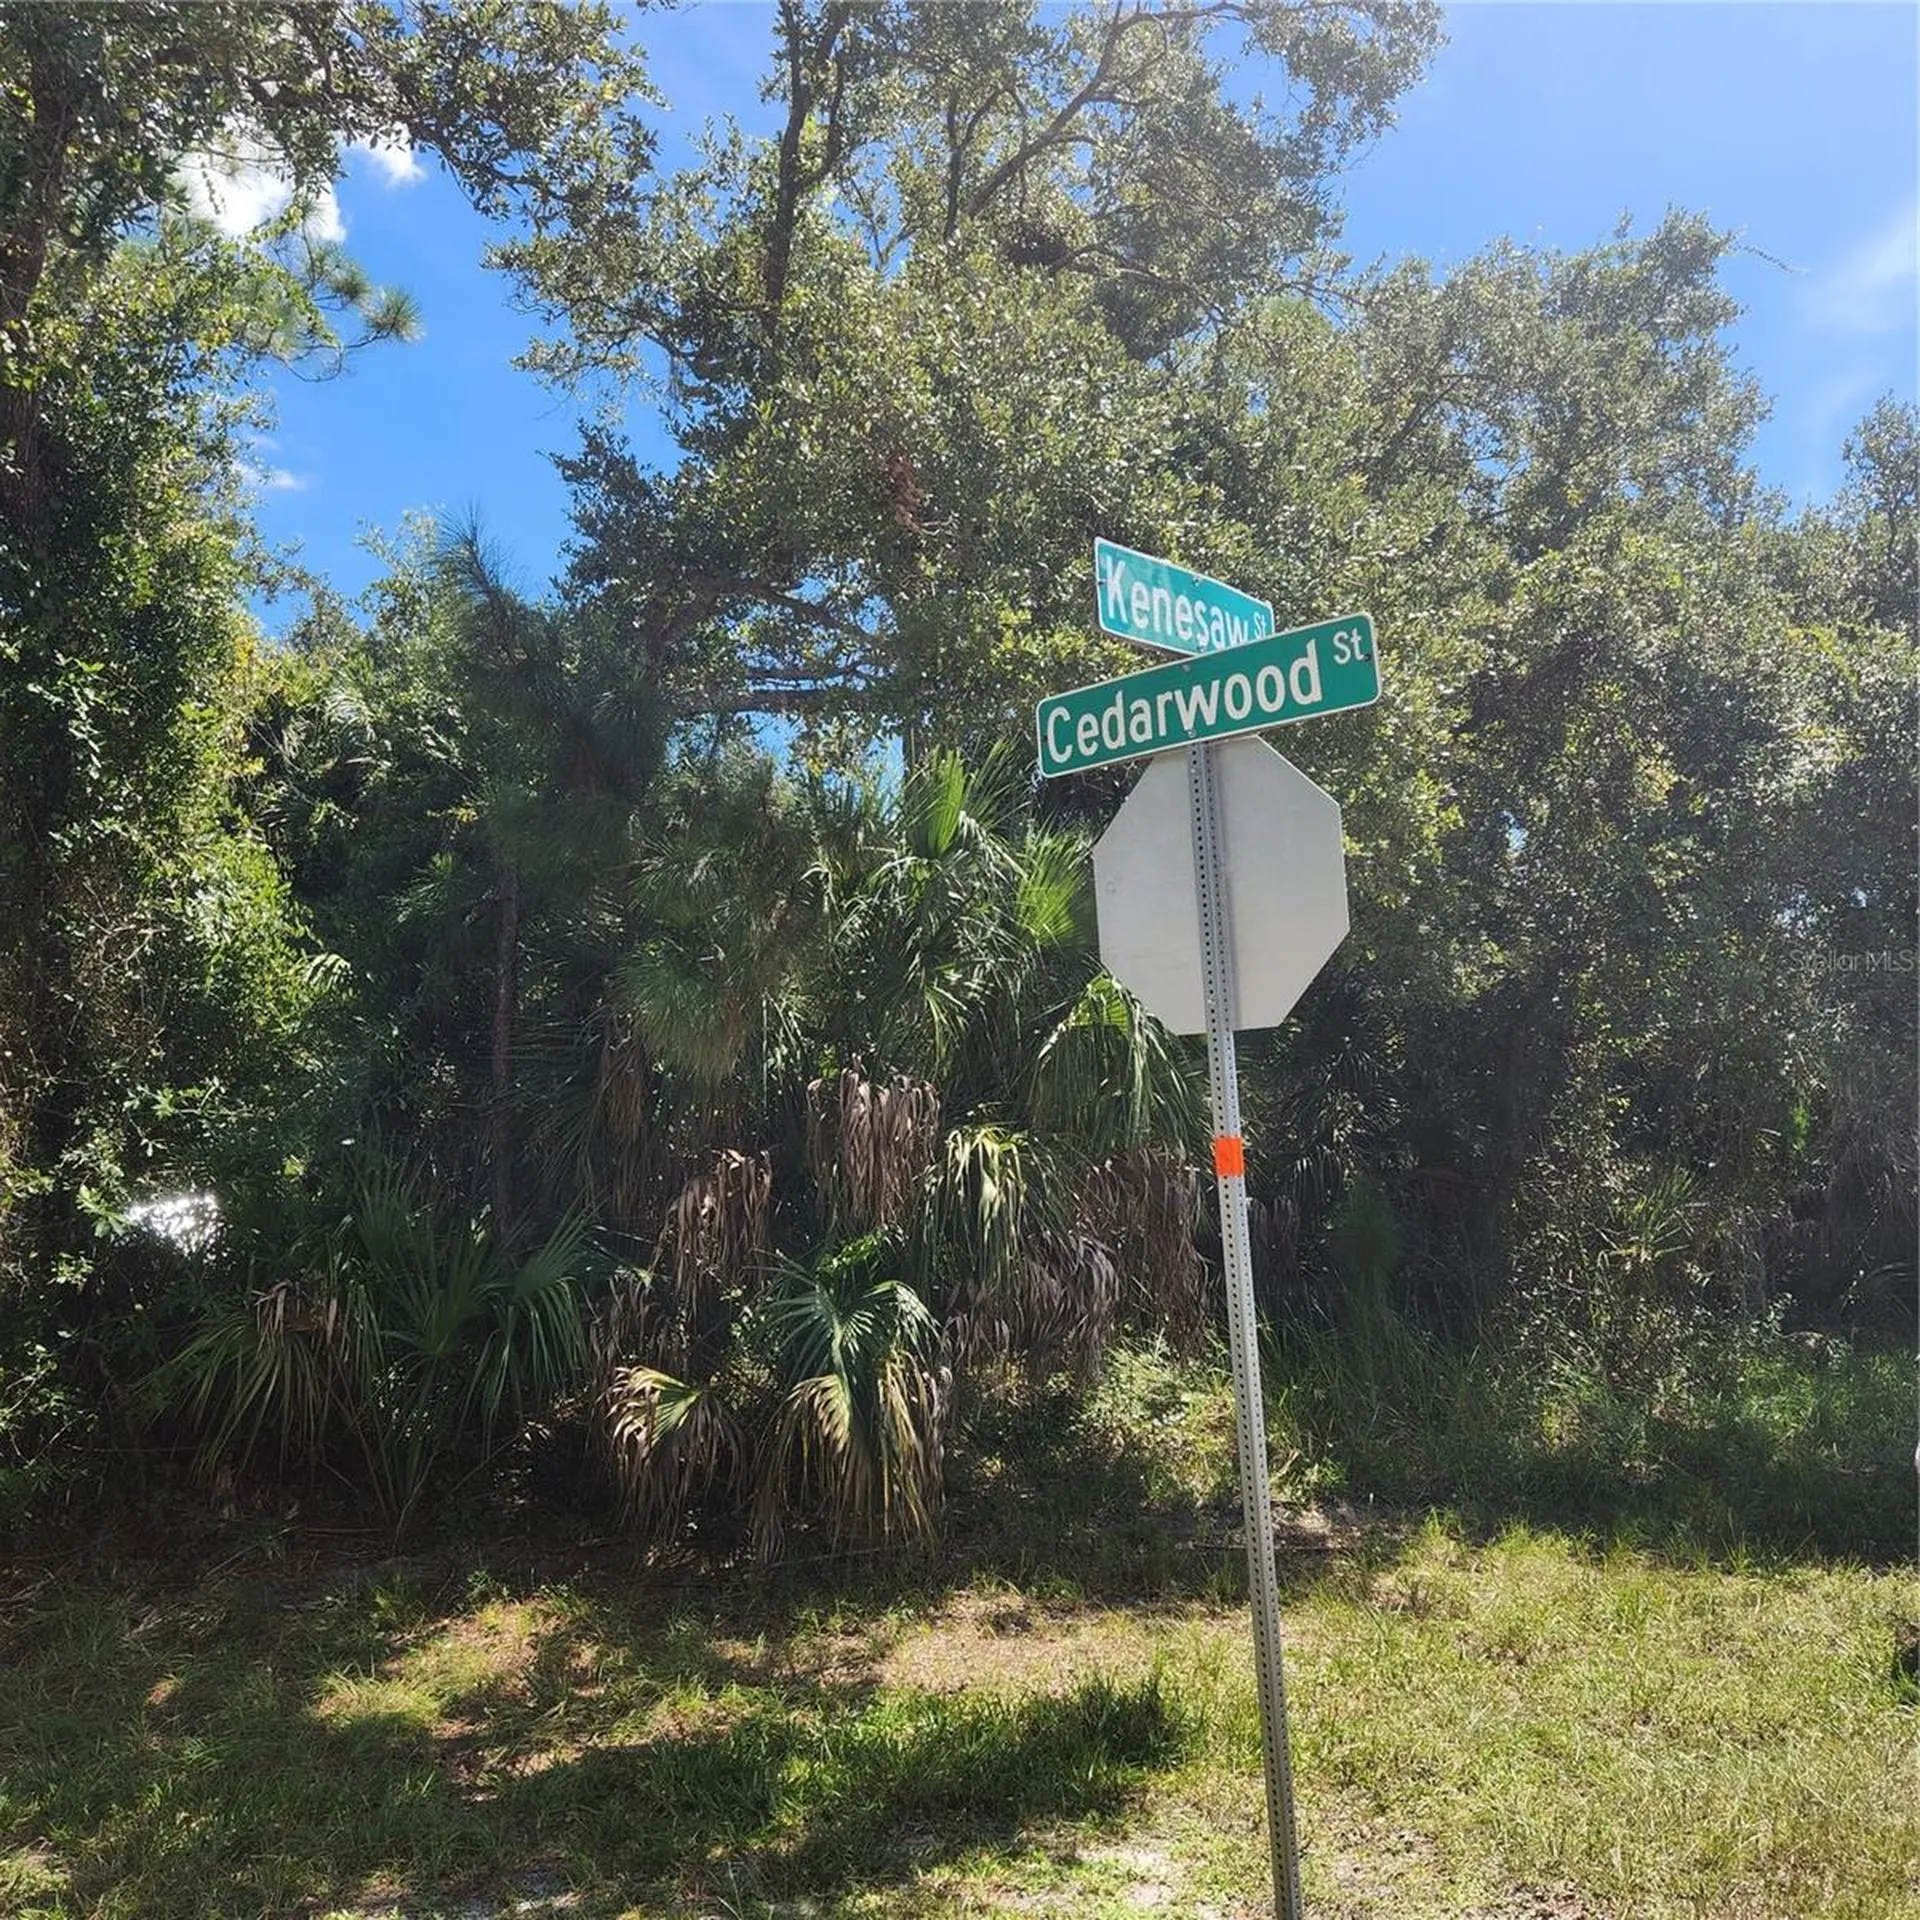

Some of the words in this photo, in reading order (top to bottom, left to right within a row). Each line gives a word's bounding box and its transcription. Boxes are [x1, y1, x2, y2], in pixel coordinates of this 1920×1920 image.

[1106, 555, 1248, 651] Kenesaw
[1253, 611, 1267, 640] St
[1046, 638, 1323, 764] Cedarwood
[1333, 627, 1364, 665] St
